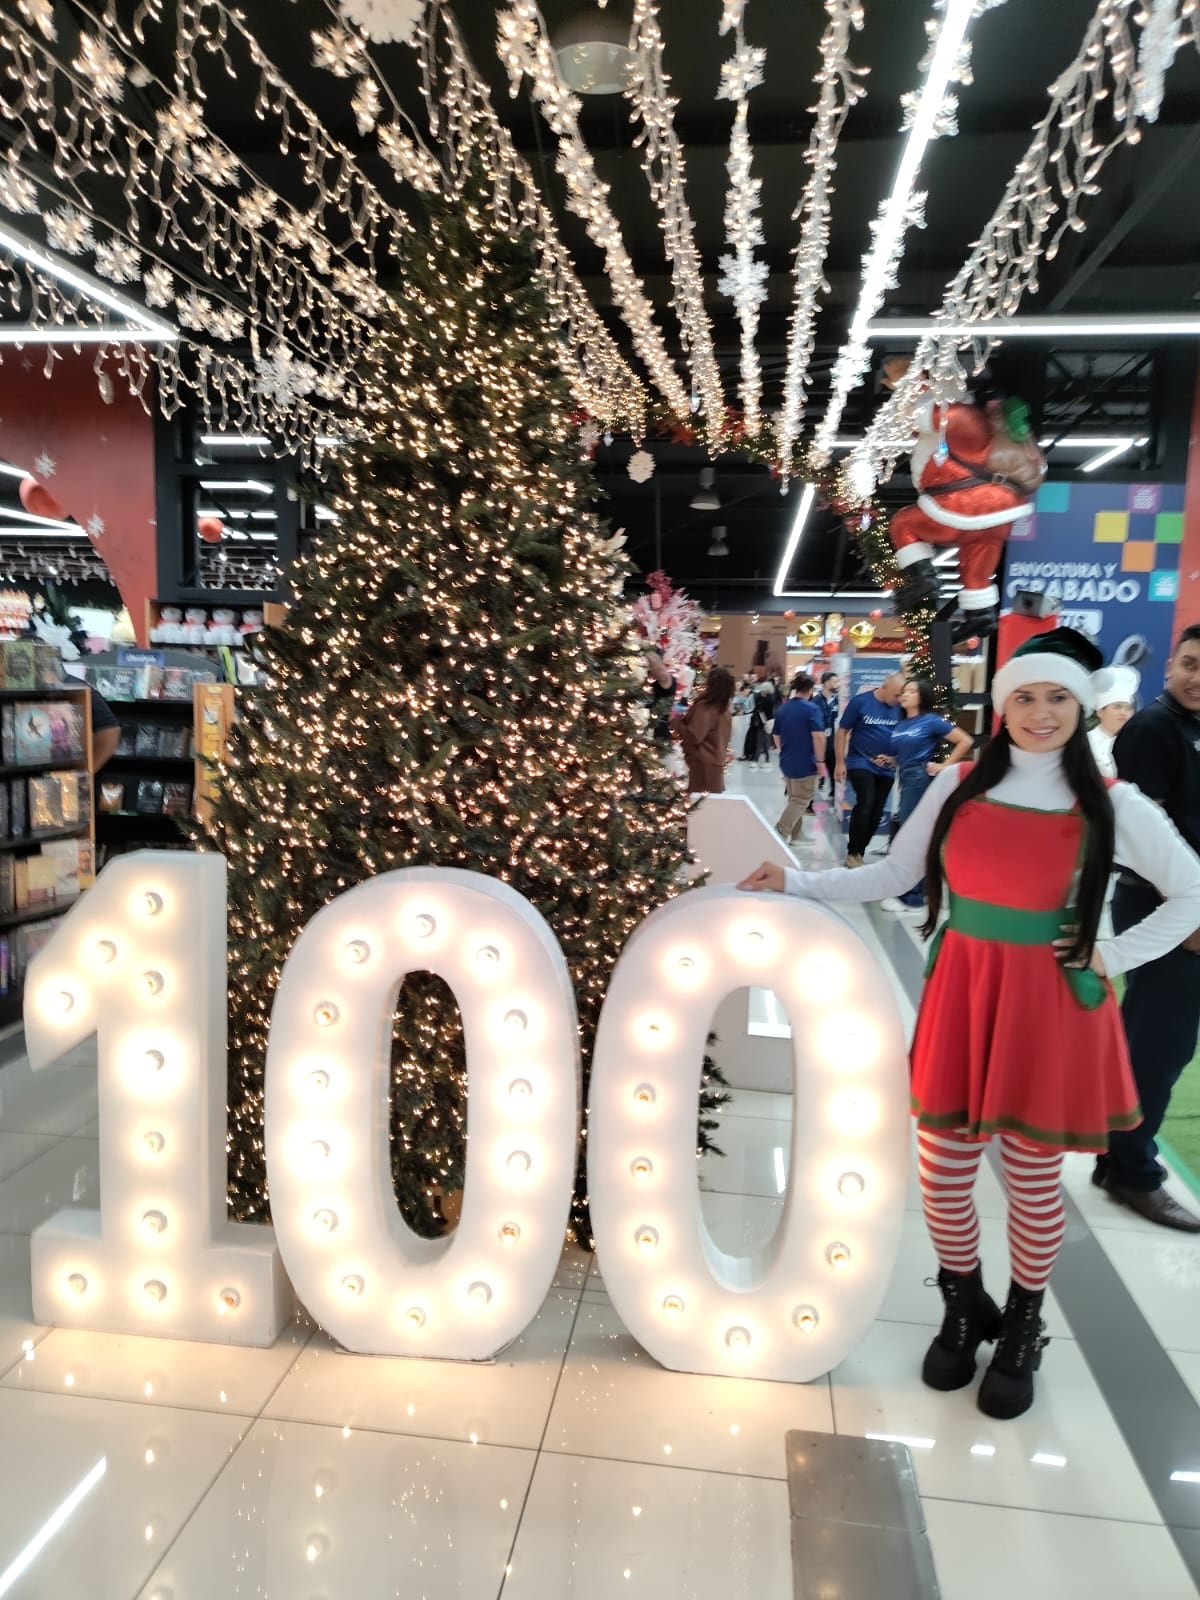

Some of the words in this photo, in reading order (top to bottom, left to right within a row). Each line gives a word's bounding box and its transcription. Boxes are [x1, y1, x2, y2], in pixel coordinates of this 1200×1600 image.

[1009, 561, 1100, 578] ENVOLTURA
[1103, 562, 1118, 578] Y
[24, 850, 909, 1383] 100
